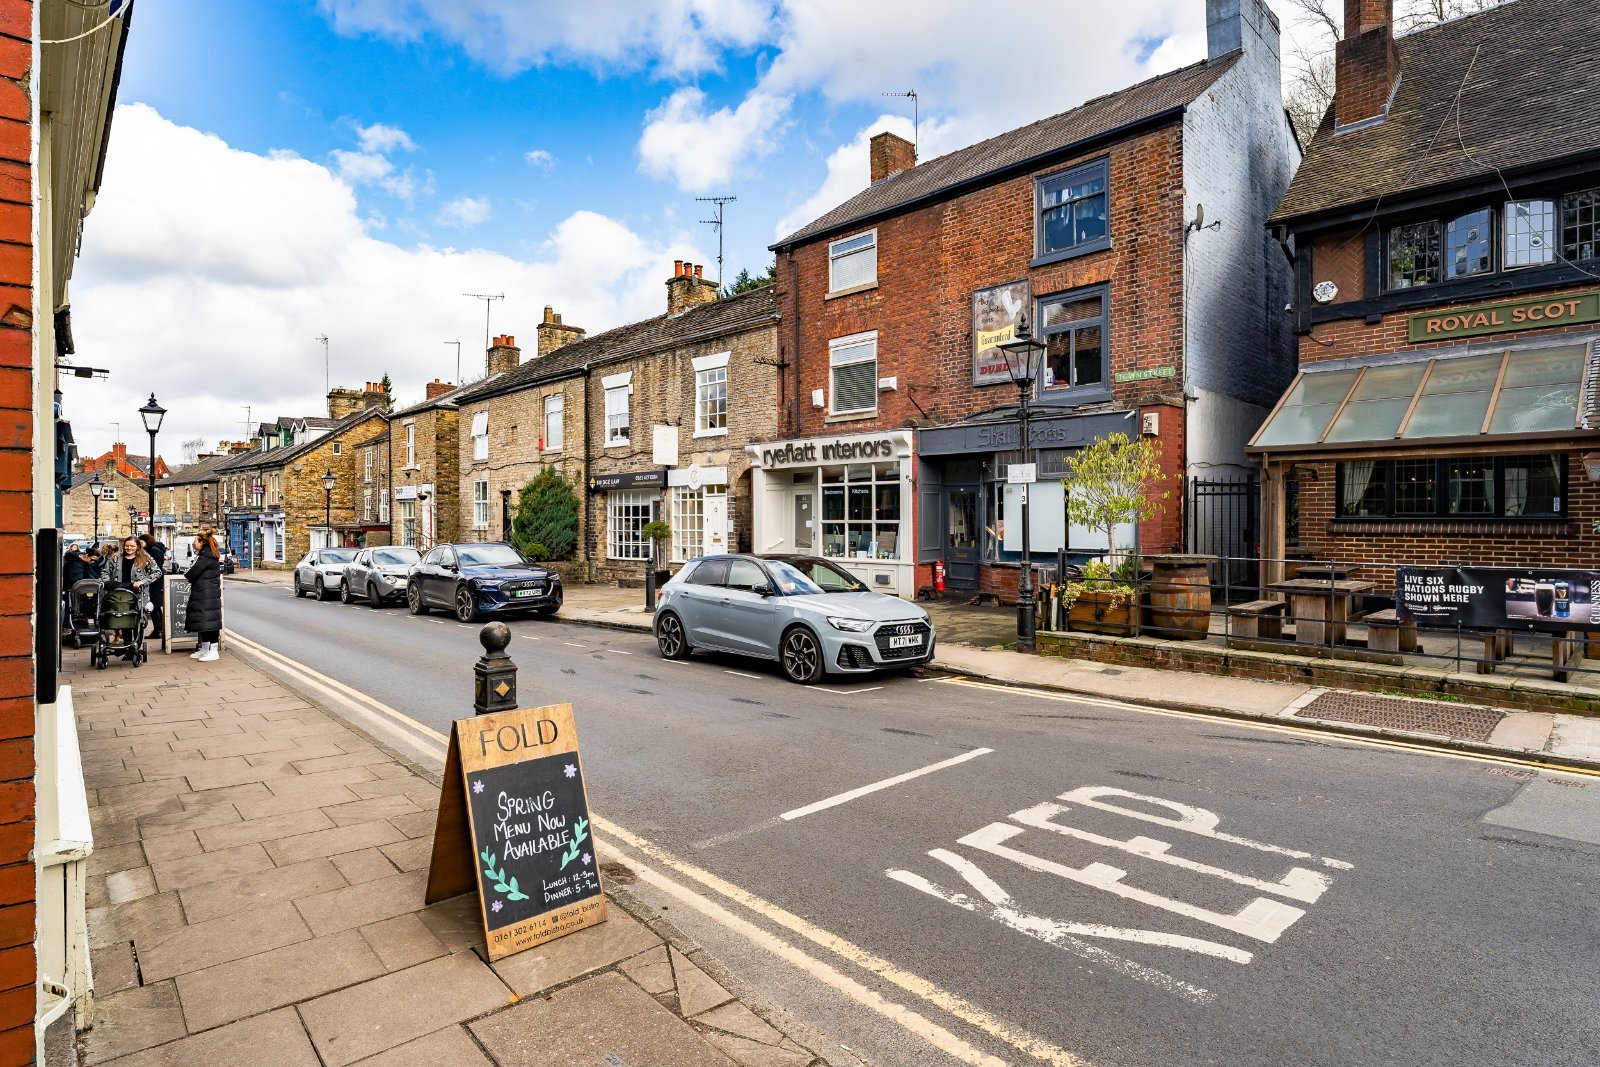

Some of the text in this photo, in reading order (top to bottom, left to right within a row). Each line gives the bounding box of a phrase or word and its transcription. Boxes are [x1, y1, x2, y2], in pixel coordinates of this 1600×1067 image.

[1426, 300, 1582, 334] ROYAL SCOT
[1119, 367, 1175, 381] TOWN STREET
[763, 440, 893, 468] ryeflatt interiors
[1404, 575, 1444, 585] LIVE SIX
[1404, 584, 1484, 595] NATIONS RUGBY
[1404, 593, 1470, 603] SHOWN HERE
[1590, 580, 1600, 624] GUINNESS
[479, 719, 558, 757] FOLD
[884, 785, 1356, 1006] KEEP
[494, 931, 513, 943] 0161
[513, 926, 528, 937] 302
[529, 919, 547, 931] 6114
[515, 916, 585, 947] www.foldbistro.co.uk
